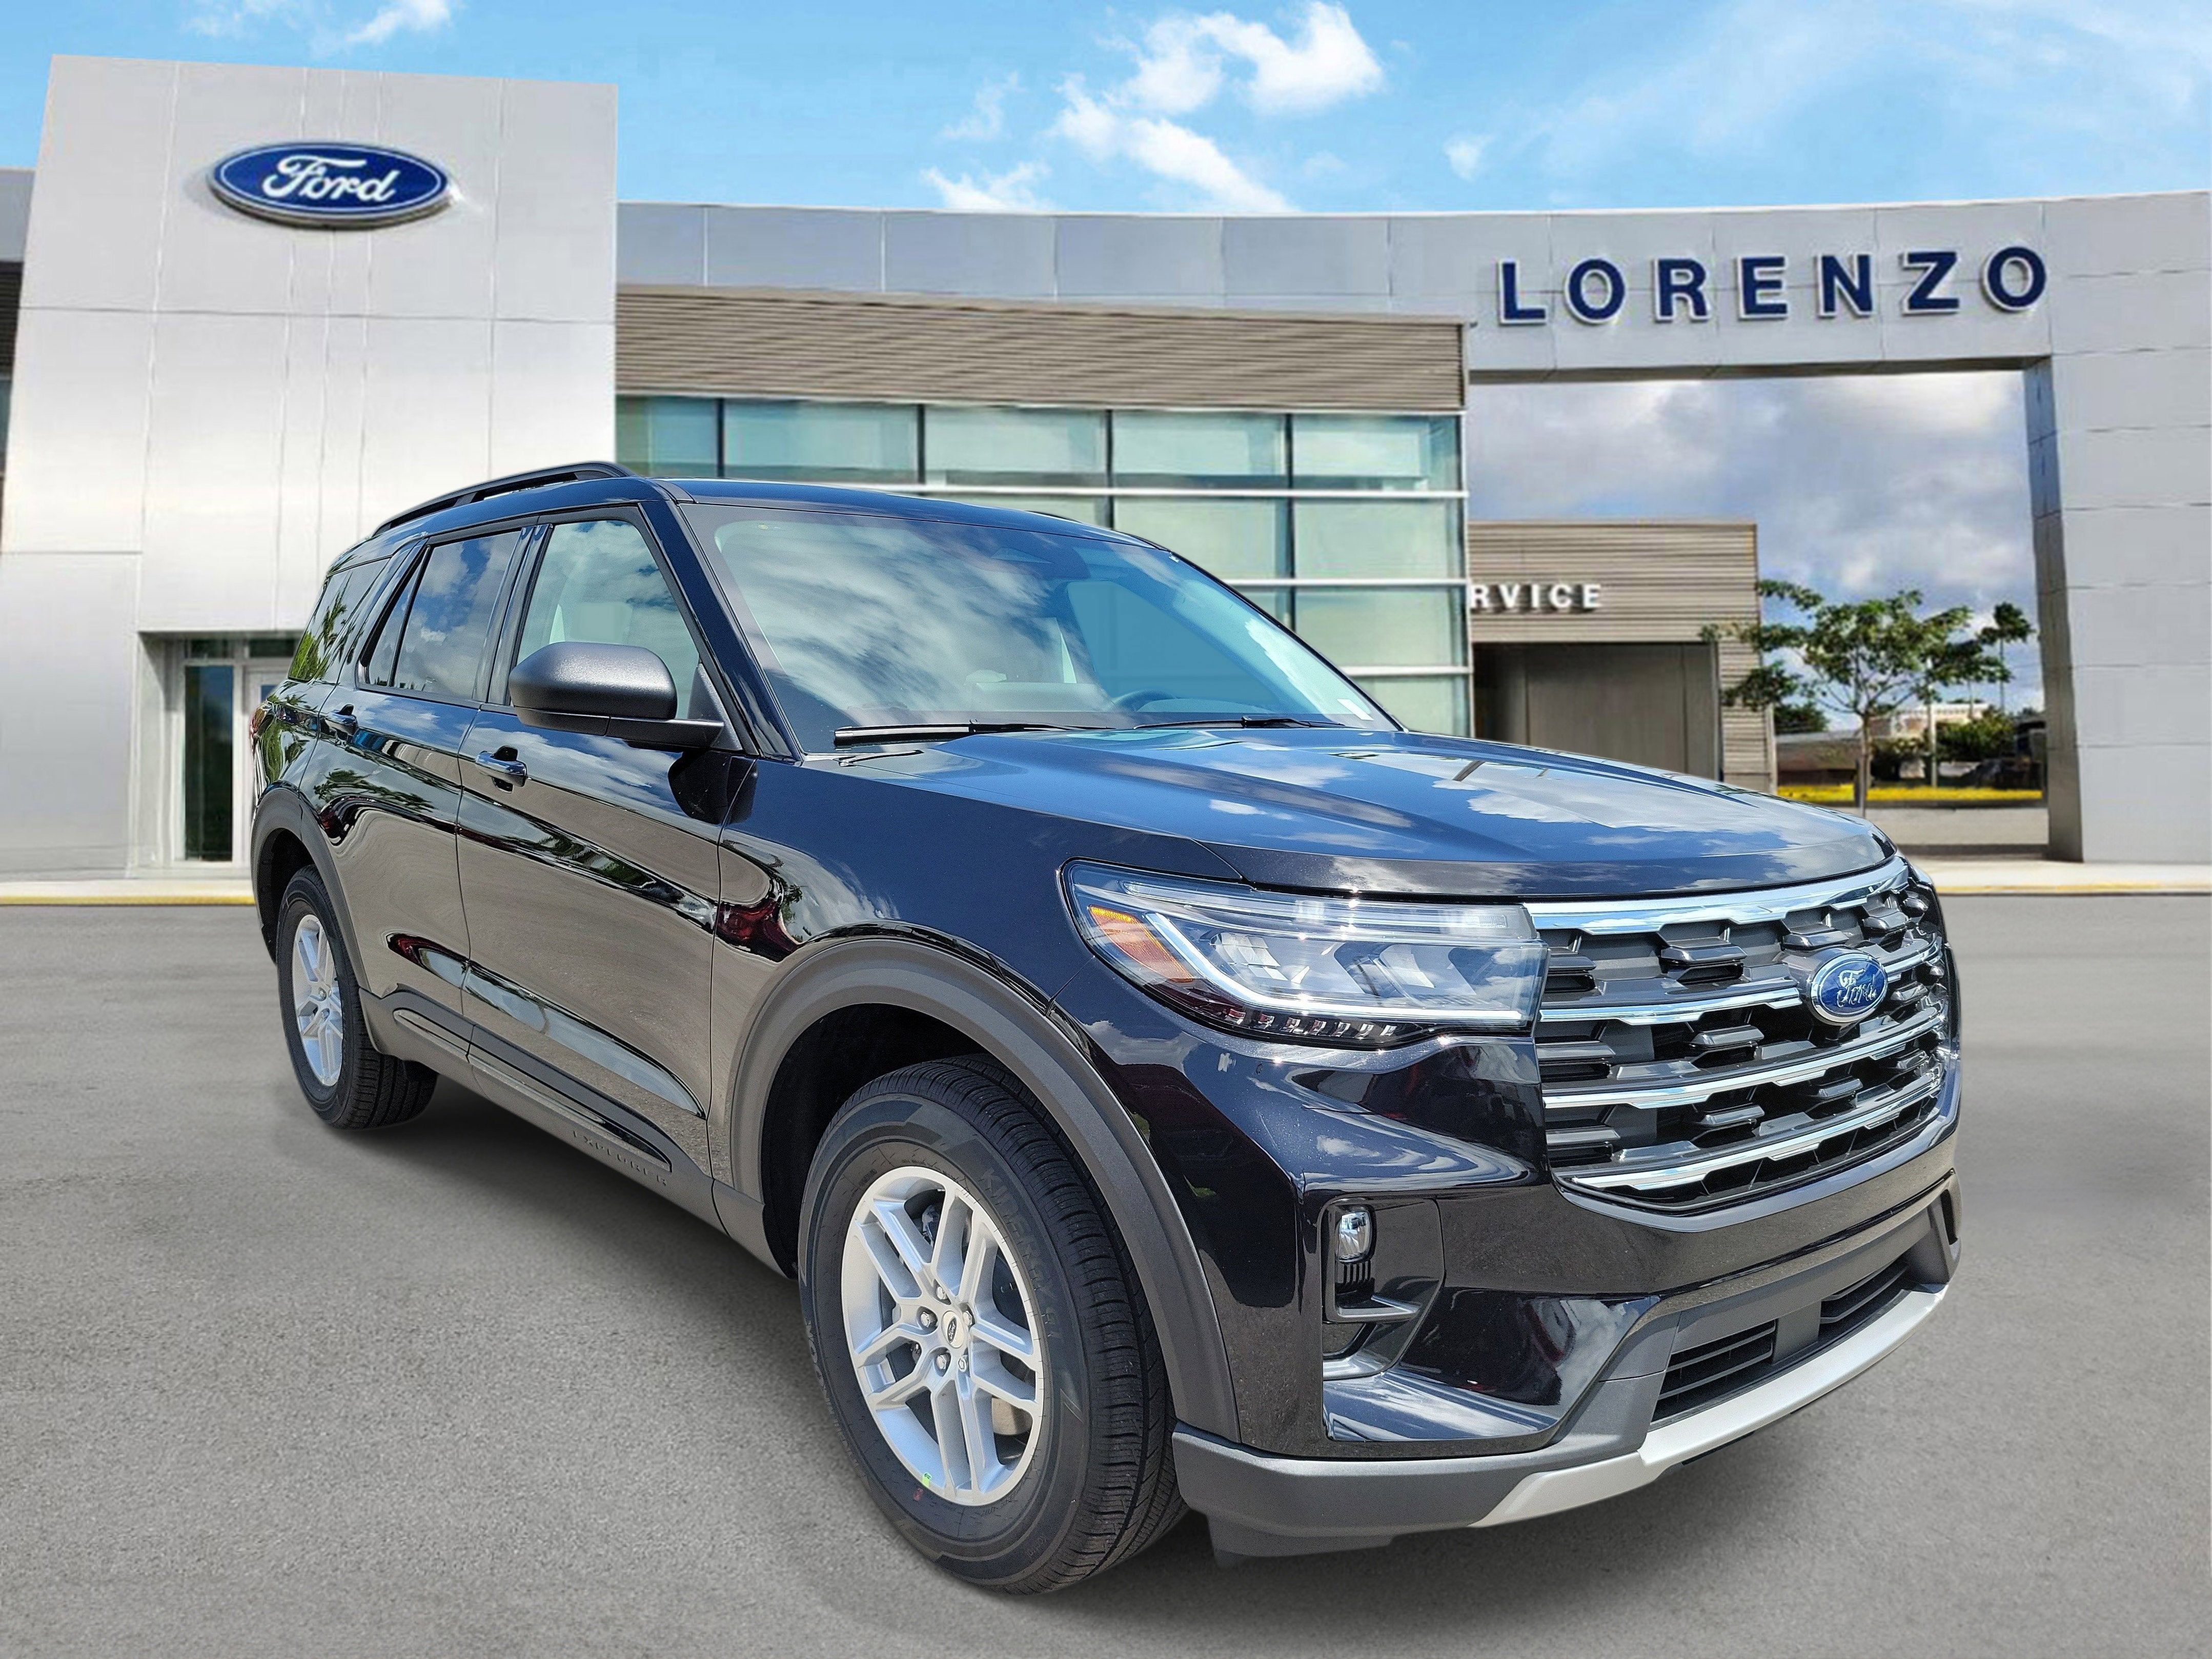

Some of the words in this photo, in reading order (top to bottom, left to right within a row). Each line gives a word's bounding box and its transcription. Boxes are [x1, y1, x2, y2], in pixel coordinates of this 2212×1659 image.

[262, 154, 400, 201] Ford
[1499, 247, 2046, 323] LORENZO
[1837, 968, 1877, 1008] Ford
